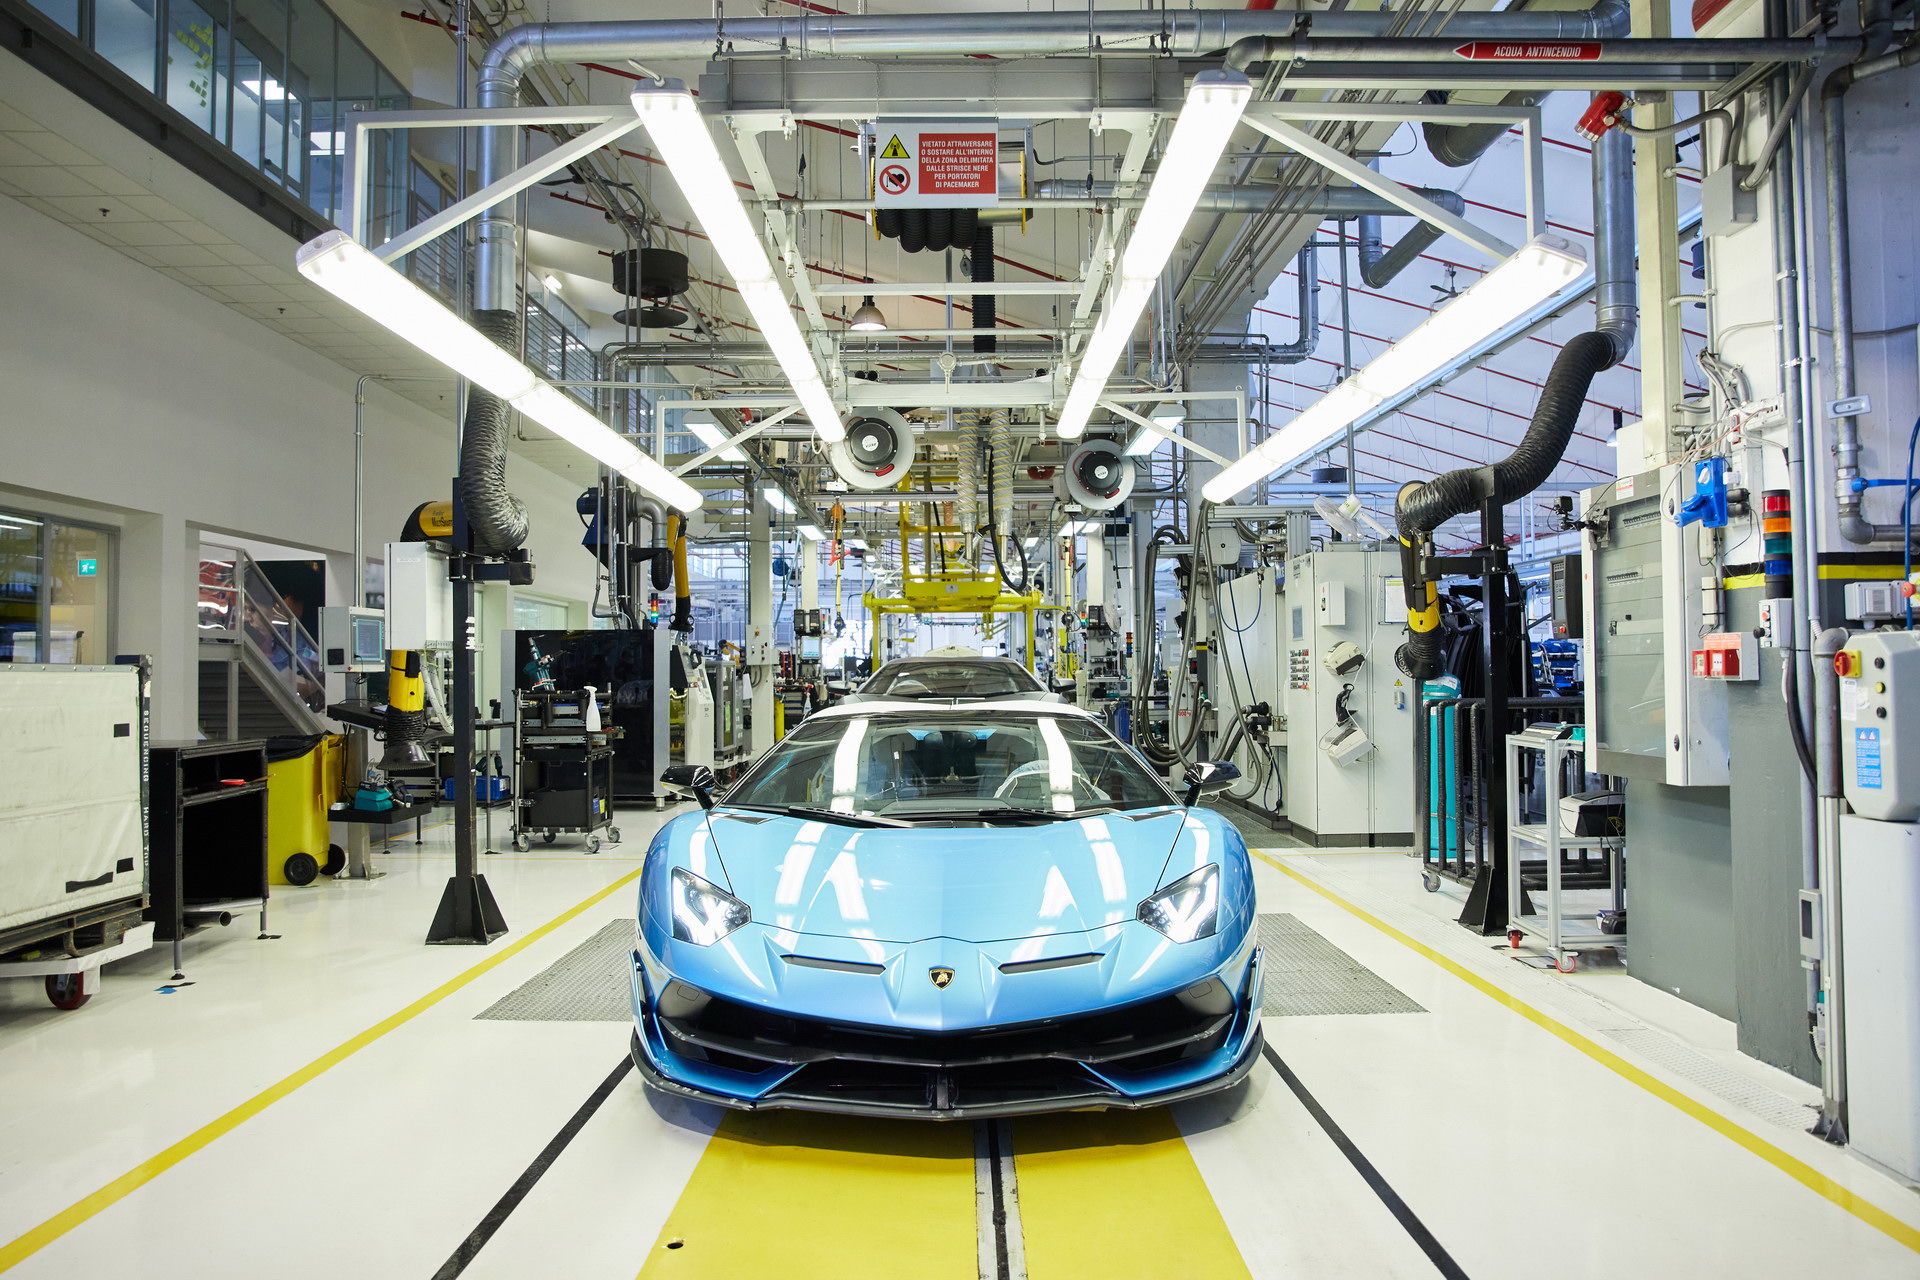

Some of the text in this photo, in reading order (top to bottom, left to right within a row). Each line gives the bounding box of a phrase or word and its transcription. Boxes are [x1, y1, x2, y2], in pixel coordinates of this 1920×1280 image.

[1493, 46, 1582, 58] ACQUA ANTINCENDIO
[922, 140, 993, 148] VIETATO ATTRAVERSARE
[921, 148, 994, 156] O SOSTARE ALL'INTERNO
[921, 156, 994, 164] DELLA ZONA DELIMITATA
[926, 164, 989, 172] DALLE STRISCE NERE
